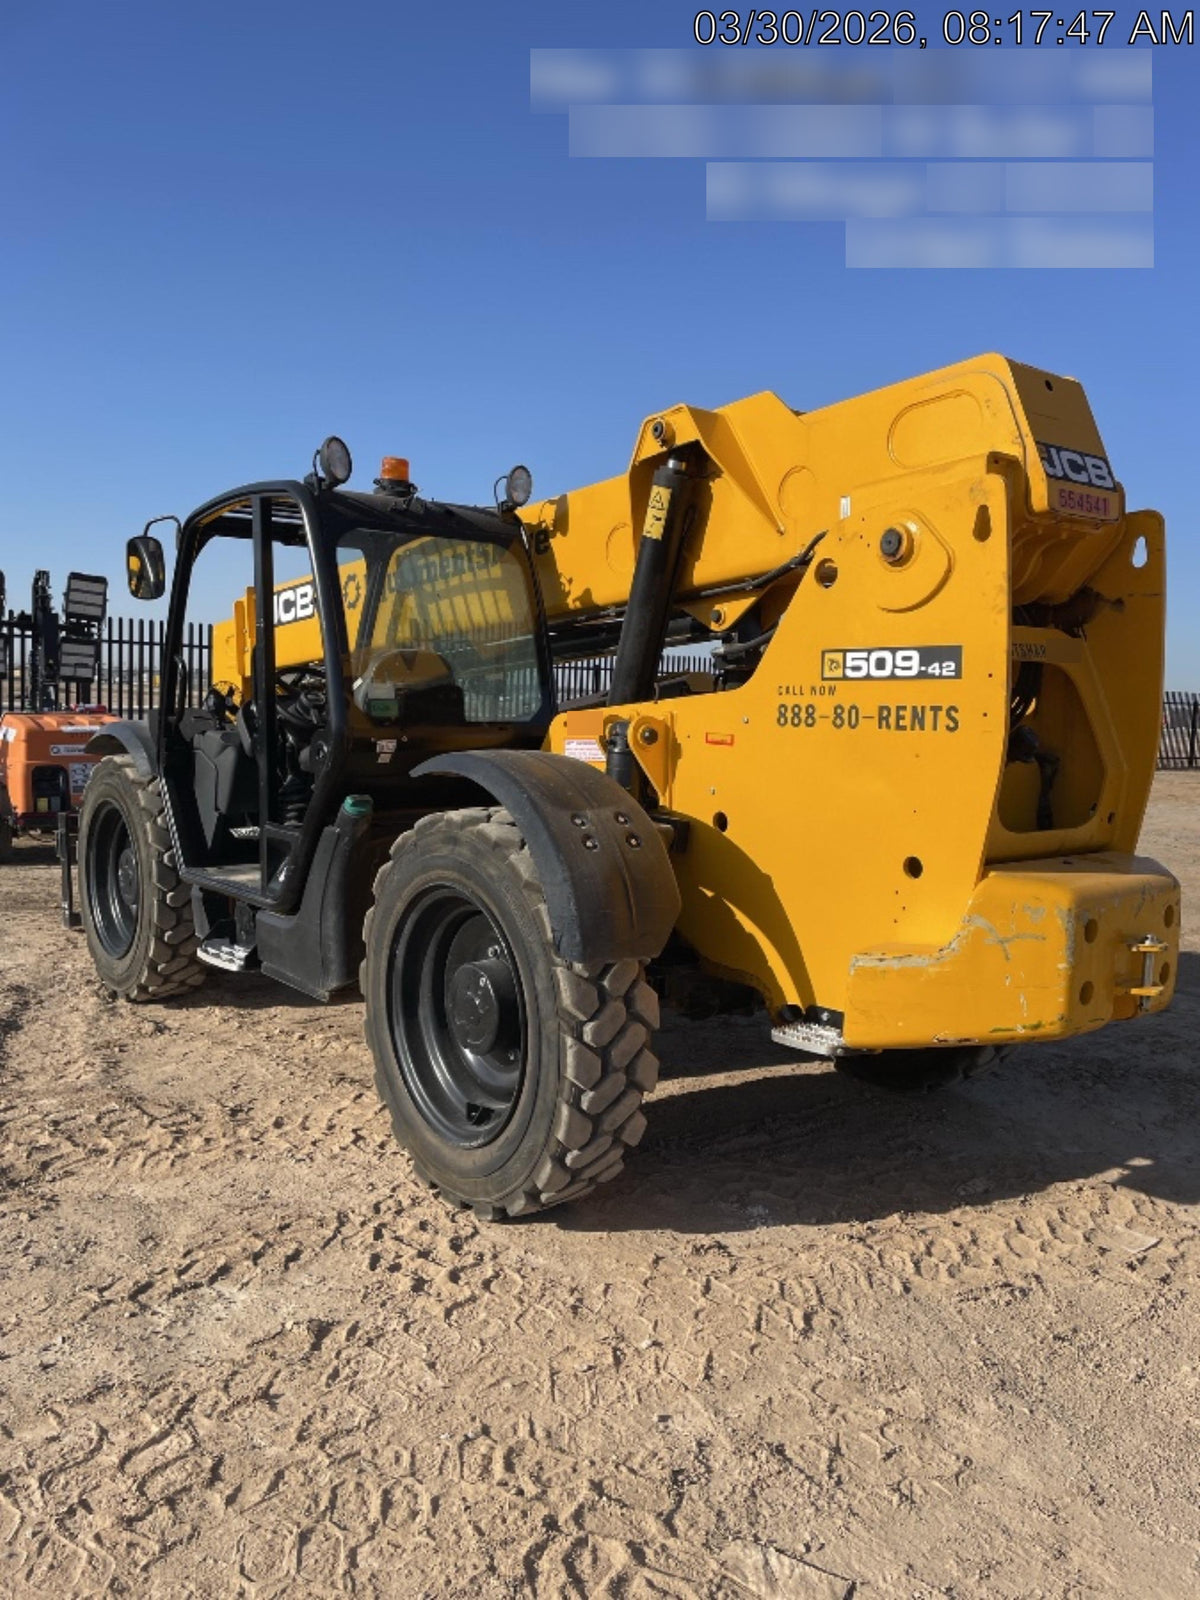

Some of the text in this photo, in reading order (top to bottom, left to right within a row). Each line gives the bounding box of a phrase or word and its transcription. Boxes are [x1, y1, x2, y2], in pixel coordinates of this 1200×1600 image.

[1041, 446, 1115, 489] JCB
[844, 649, 956, 678] 509-42
[777, 685, 837, 697] CALL NOW
[776, 703, 960, 733] 888-80-RENTS
